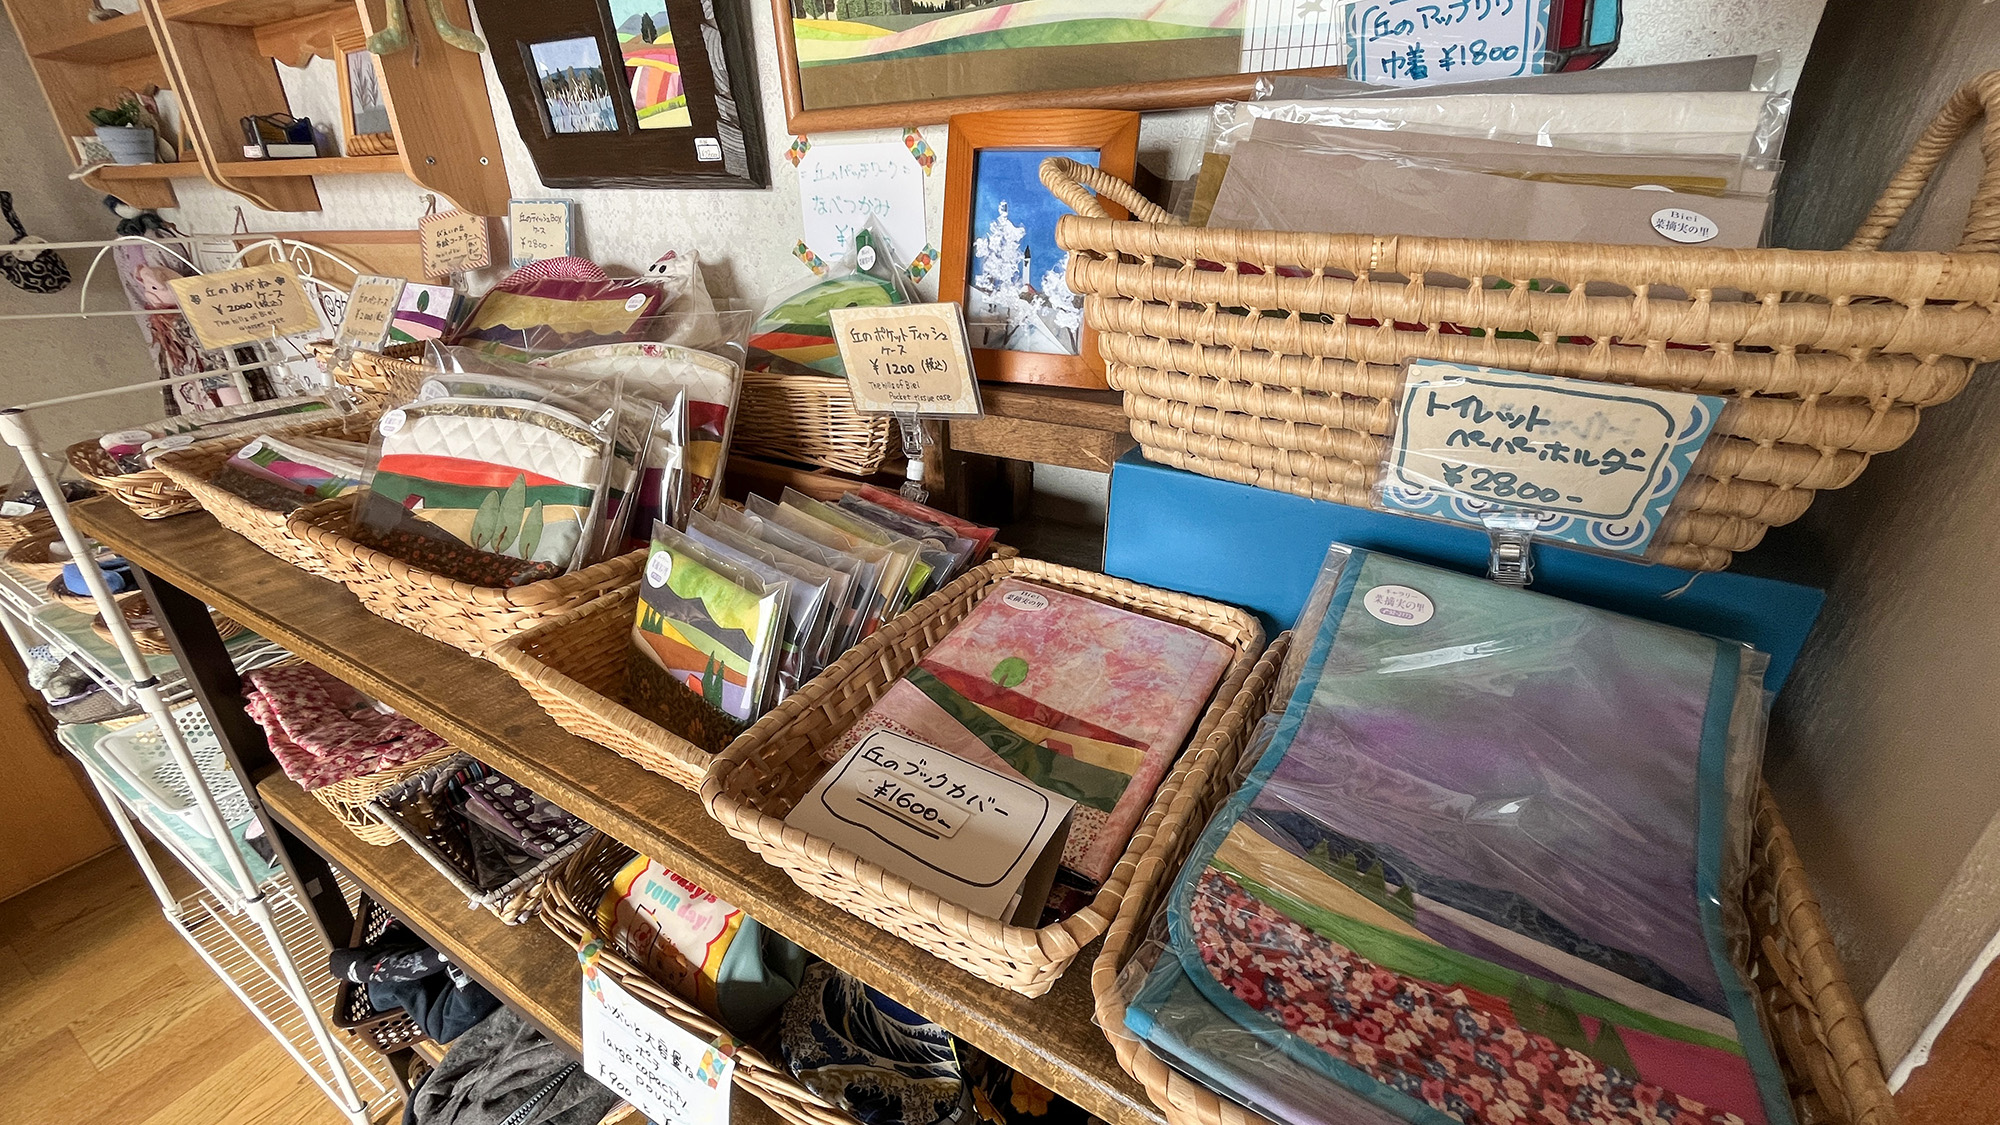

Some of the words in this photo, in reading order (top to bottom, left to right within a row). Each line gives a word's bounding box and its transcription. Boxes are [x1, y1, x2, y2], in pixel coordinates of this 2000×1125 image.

[1369, 0, 1513, 42] 丘のアップリ
[1382, 42, 1428, 80] 巾着
[1439, 39, 1519, 71] ¥1800
[812, 195, 891, 217] なべつかみ
[205, 278, 272, 298] 丘のめがね
[257, 290, 285, 302] ケース
[881, 345, 907, 356] ケース
[861, 746, 1009, 817] 丘のブックカバー
